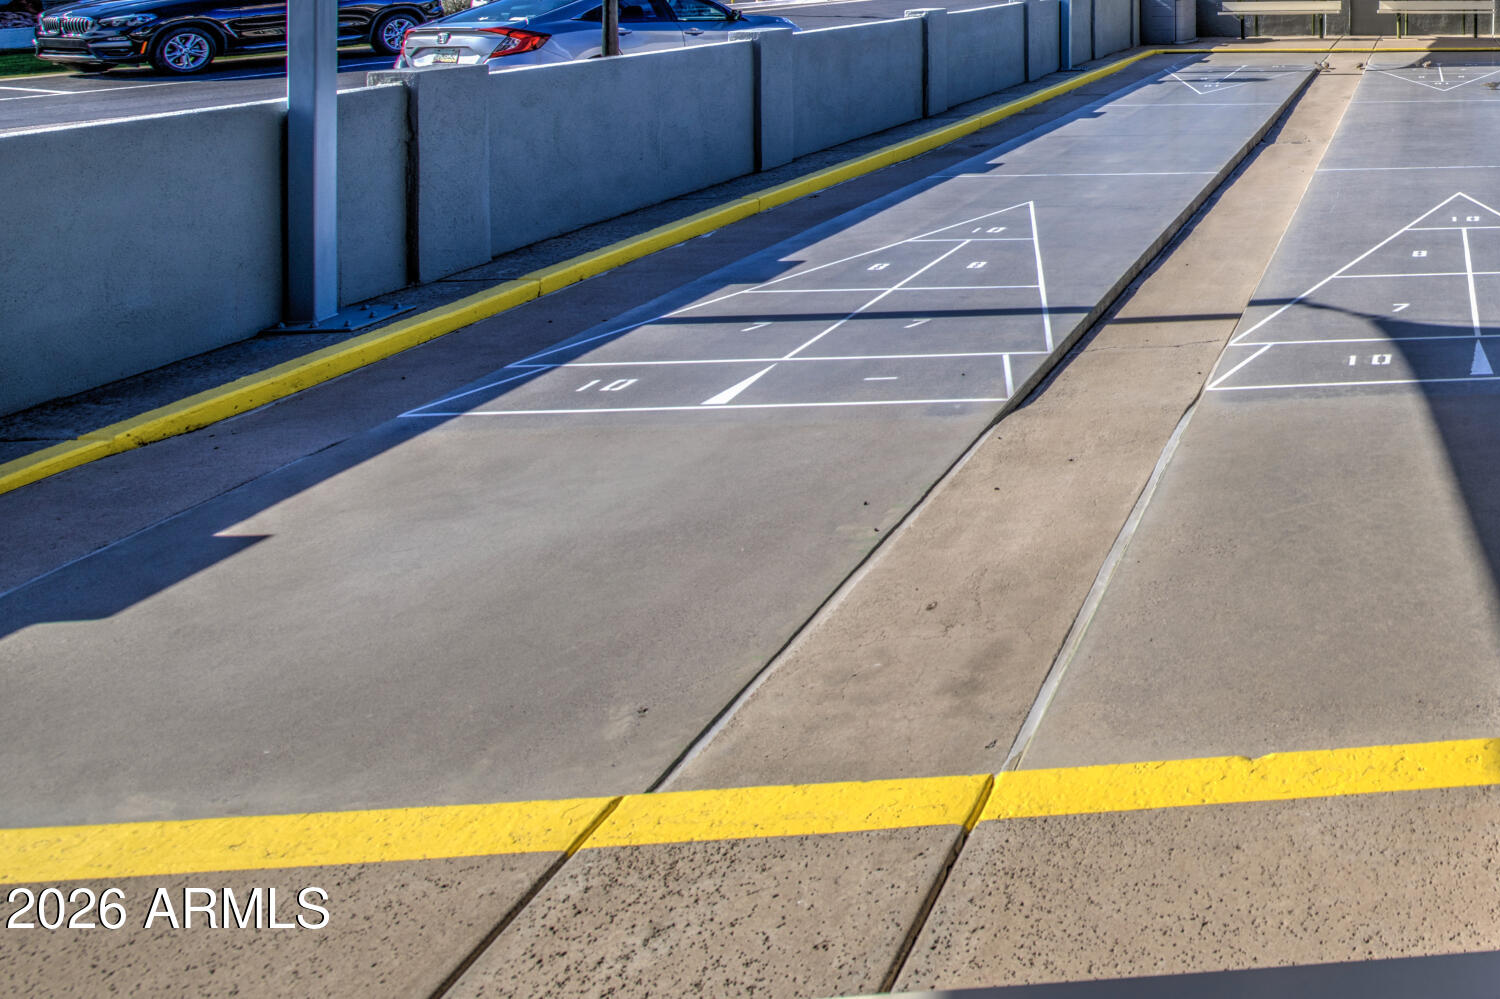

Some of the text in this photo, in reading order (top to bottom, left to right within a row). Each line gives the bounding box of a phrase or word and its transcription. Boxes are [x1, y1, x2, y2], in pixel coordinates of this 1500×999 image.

[1393, 303, 1411, 312] 7
[1348, 353, 1392, 366] 10
[575, 378, 639, 392] 10
